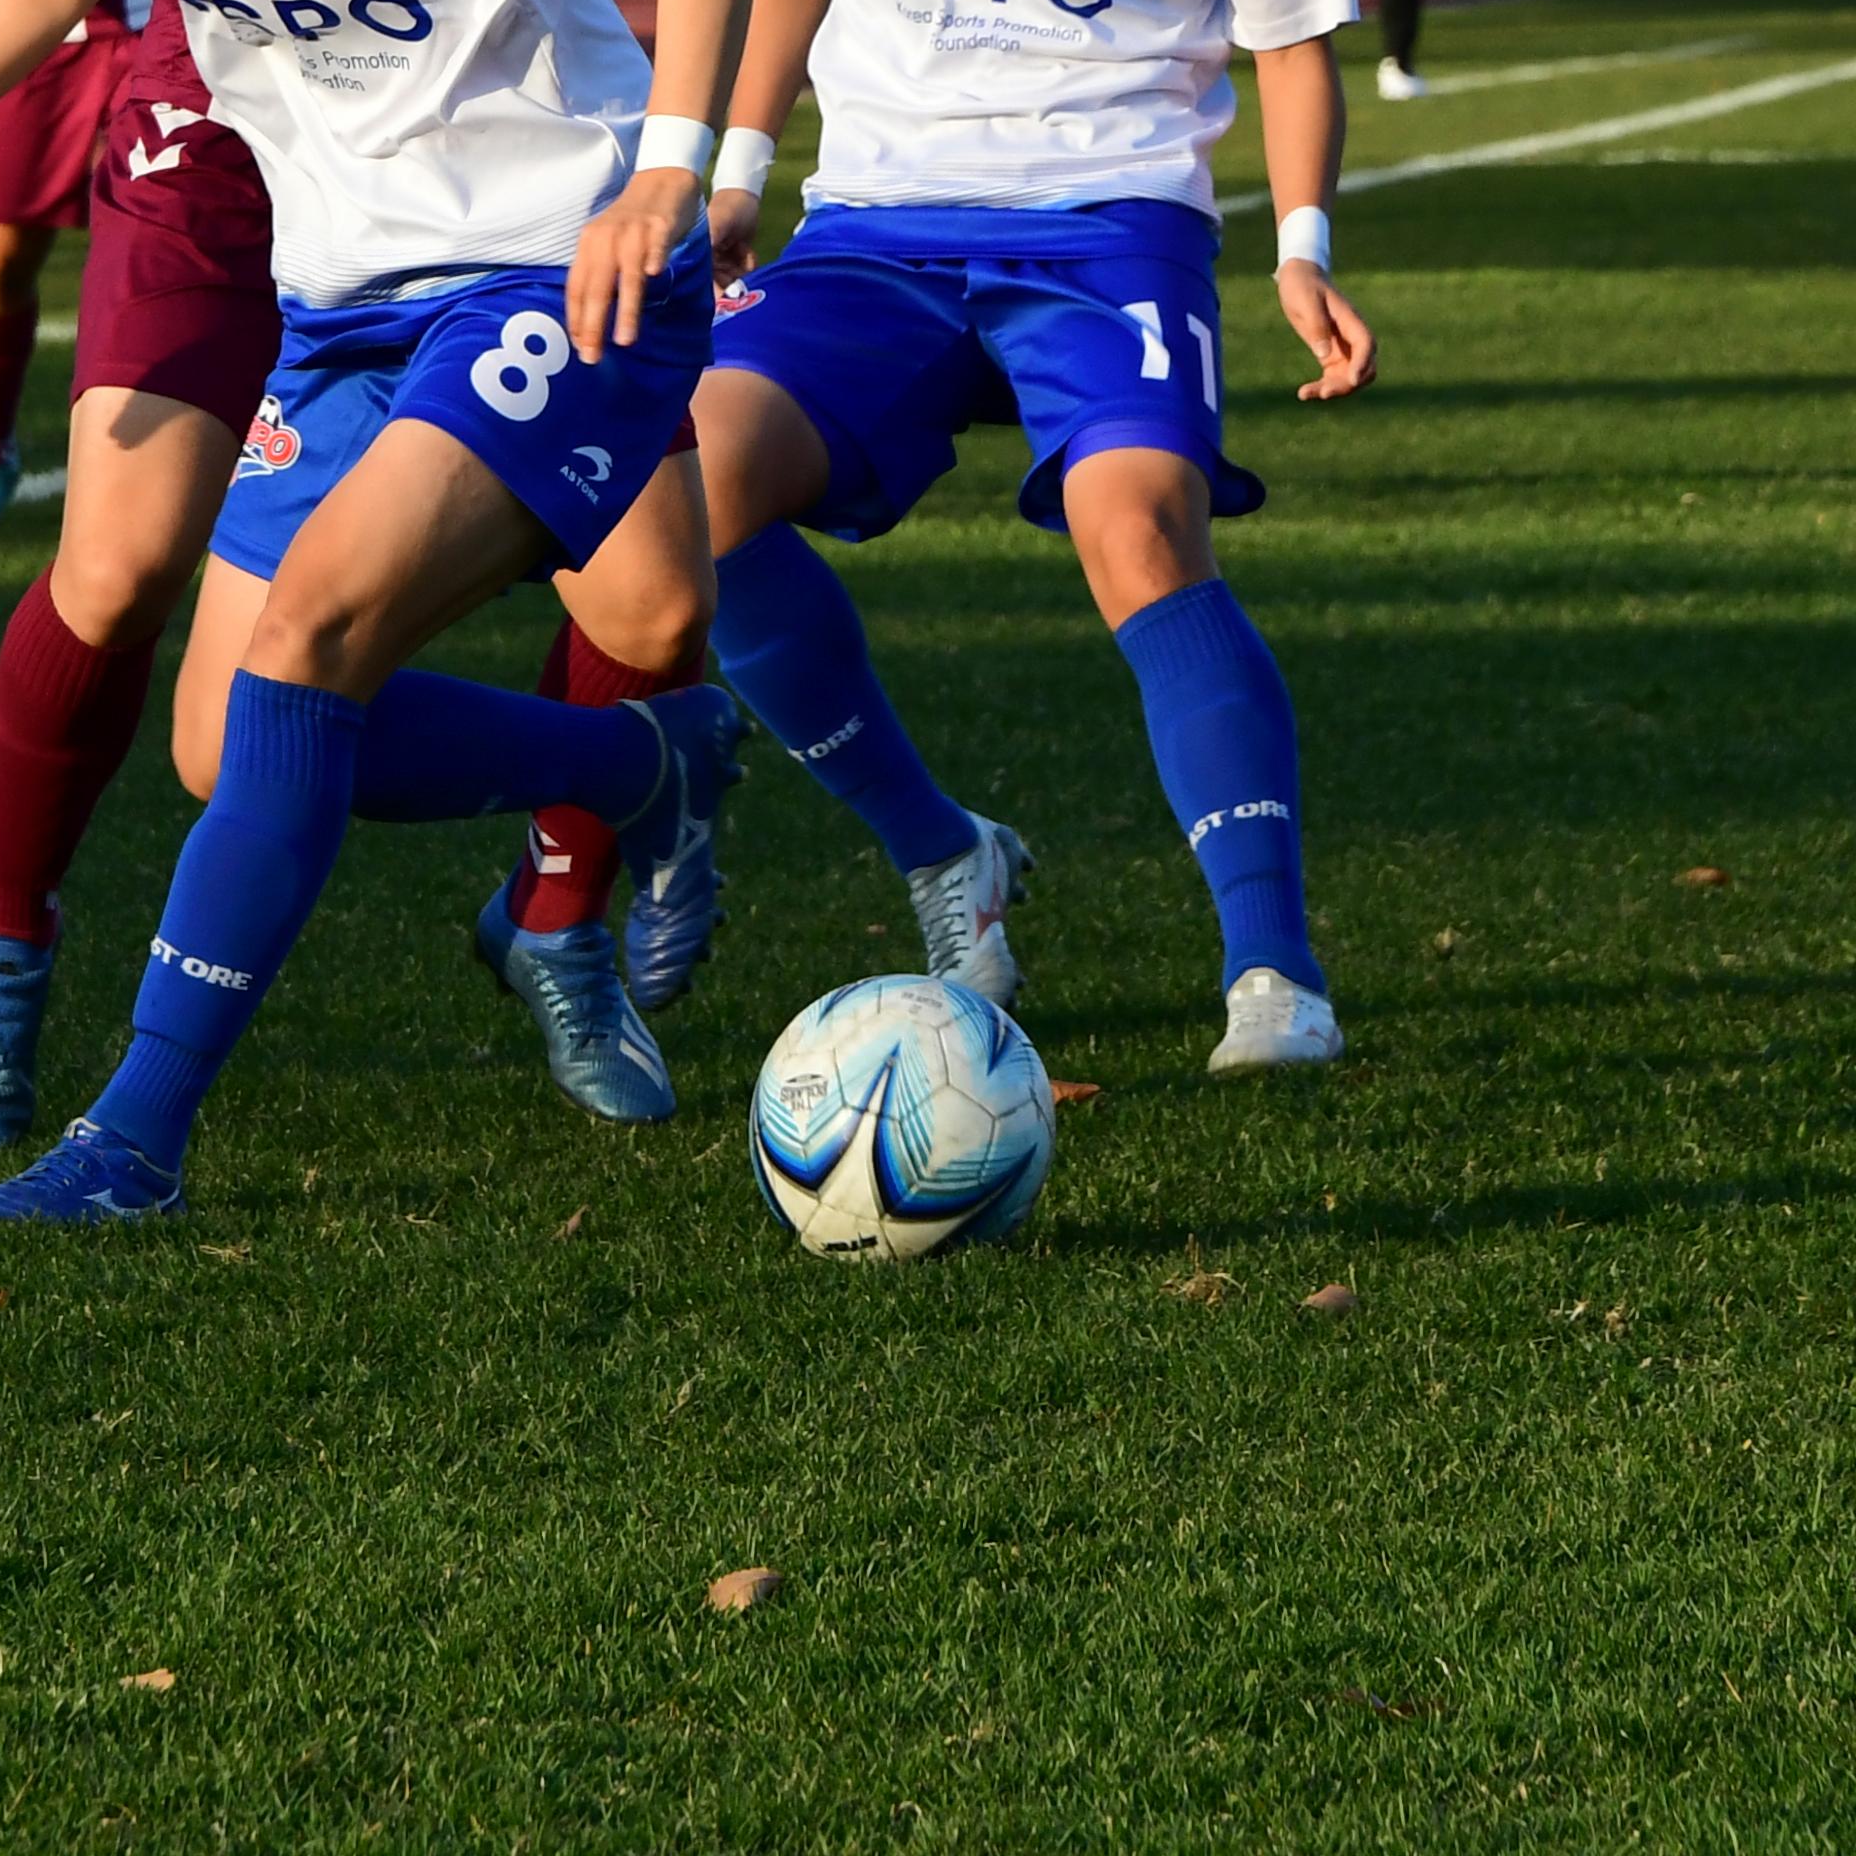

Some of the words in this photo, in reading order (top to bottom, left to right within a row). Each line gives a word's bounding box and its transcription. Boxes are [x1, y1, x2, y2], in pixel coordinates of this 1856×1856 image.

[932, 32, 1021, 53] oundation
[994, 16, 1084, 43] Promotion
[470, 310, 571, 422] 8
[1119, 300, 1218, 415] 11
[559, 465, 600, 506] ASTORE
